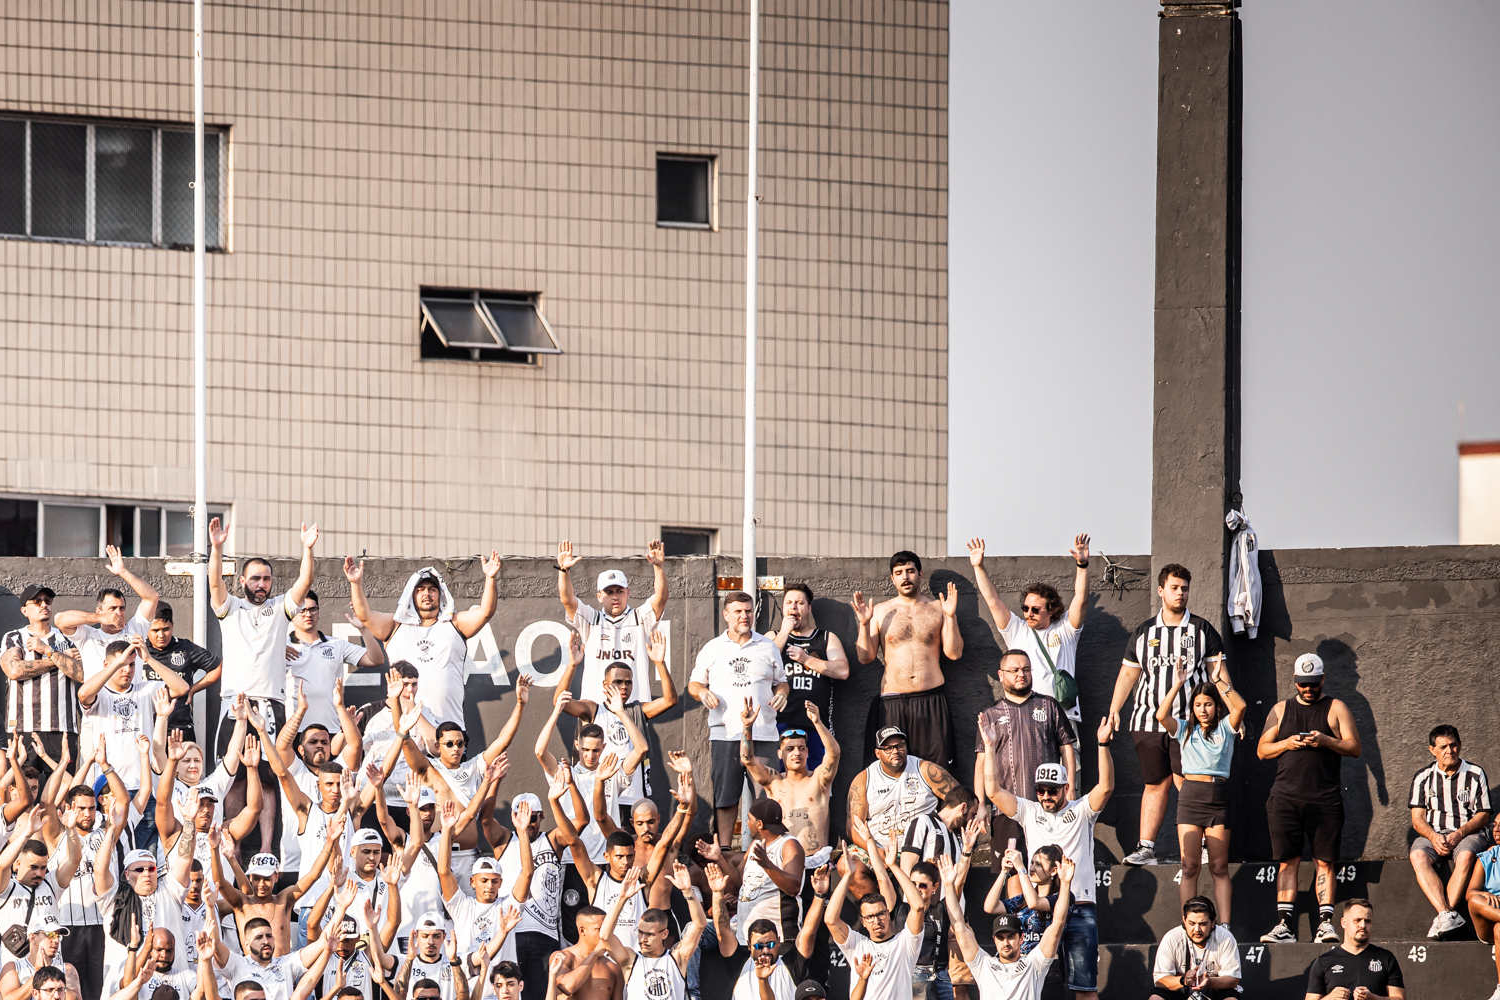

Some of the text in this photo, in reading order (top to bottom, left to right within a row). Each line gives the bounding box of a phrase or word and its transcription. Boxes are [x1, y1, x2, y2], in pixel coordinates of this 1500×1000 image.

[792, 676, 813, 690] 013
[1037, 770, 1059, 780] 1912
[1095, 869, 1111, 887] 46
[1255, 866, 1275, 883] 48
[1336, 865, 1356, 883] 49
[829, 949, 847, 967] 42
[1244, 946, 1264, 963] 47
[1407, 946, 1427, 963] 49
